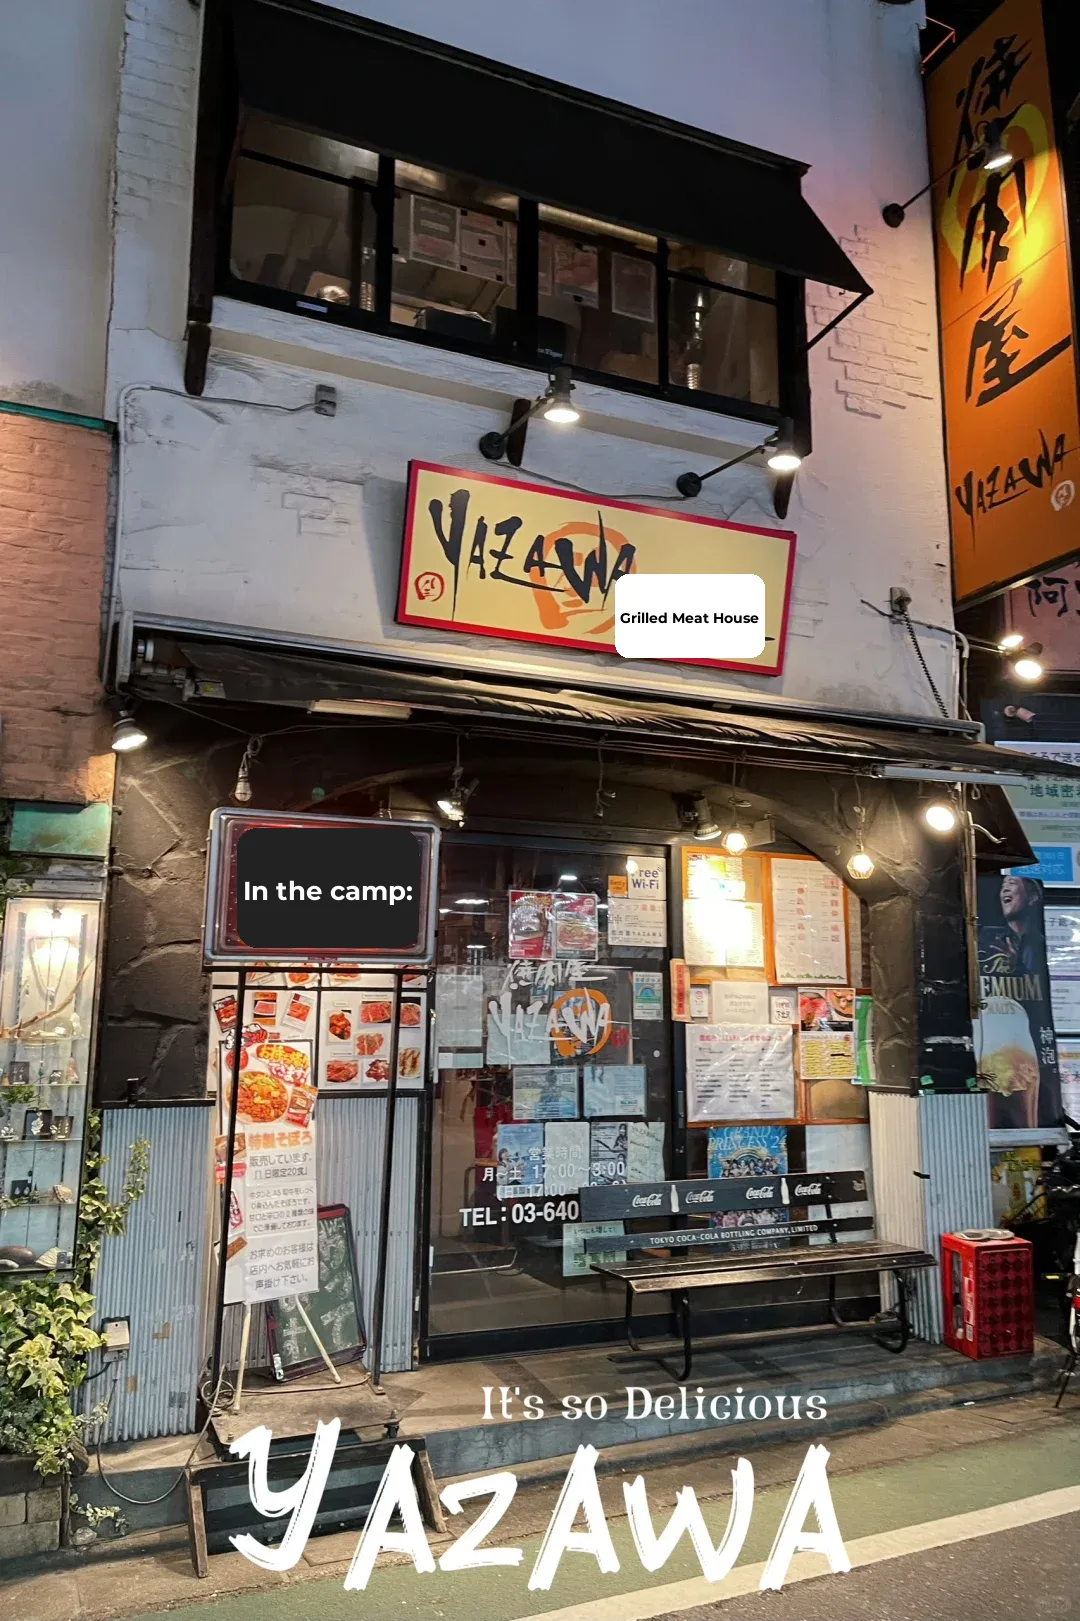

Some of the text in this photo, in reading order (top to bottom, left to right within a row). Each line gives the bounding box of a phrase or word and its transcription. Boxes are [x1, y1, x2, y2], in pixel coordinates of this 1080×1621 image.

[954, 428, 1080, 553] YAZAWA
[428, 488, 637, 622] YAZAWA
[1025, 574, 1080, 618] 阿
[631, 867, 659, 878] ree
[631, 878, 659, 889] Wi-Fi
[488, 986, 633, 1070] YAZAWA
[632, 1182, 822, 1208] Coca-Cola Coca-Cola Coca-Cola Coca-Cola
[650, 1224, 819, 1245] TOKYO COCA-COLA BOTTLING COMPANY, LIMITED
